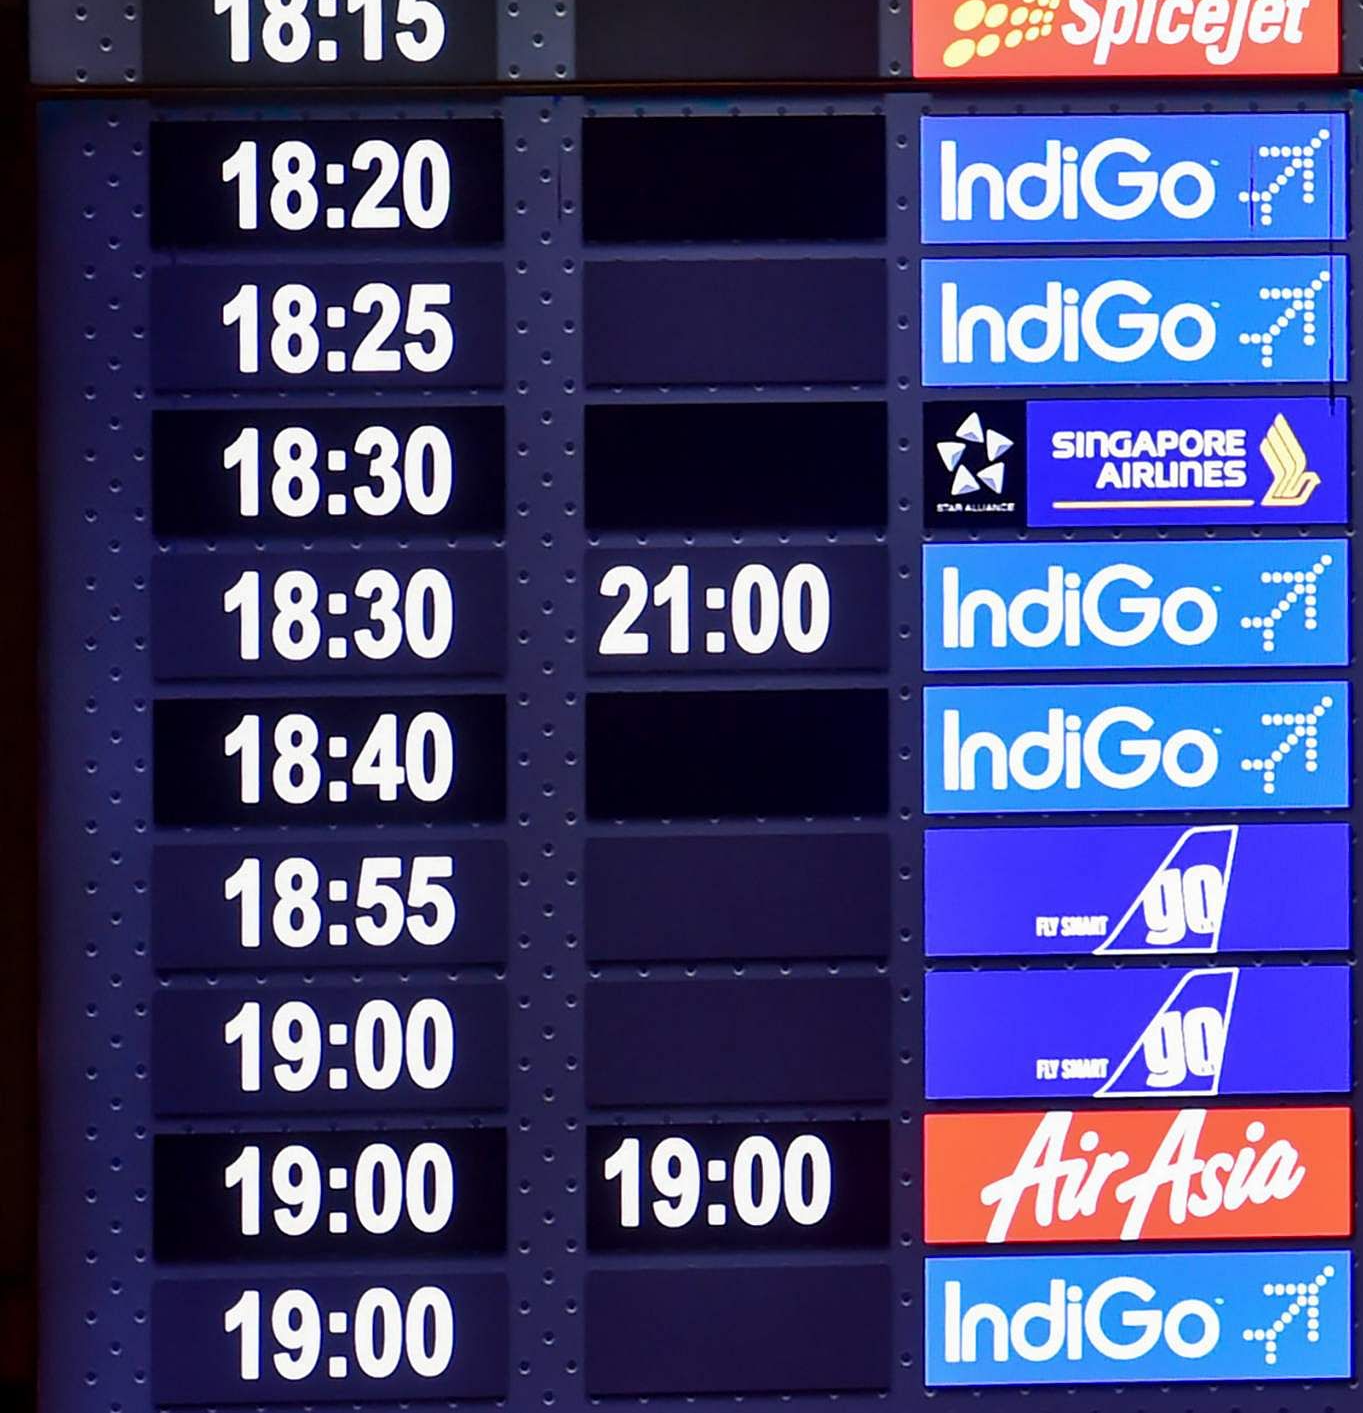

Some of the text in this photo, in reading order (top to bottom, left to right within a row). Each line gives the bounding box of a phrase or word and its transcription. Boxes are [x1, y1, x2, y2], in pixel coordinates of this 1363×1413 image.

[222, 139, 451, 231] 18:20
[940, 137, 1216, 221] IndiGo
[222, 282, 454, 374] 18:25
[941, 279, 1217, 364] IndiGo
[223, 425, 452, 518] 18:30
[1051, 429, 1247, 459] SINGAPORE
[1095, 459, 1247, 489] AIRLINES
[936, 502, 1015, 513] STAR ALLIANCE
[224, 568, 453, 661] 18:30
[598, 563, 830, 655] 21:00
[942, 563, 1218, 649] IndiGo
[224, 711, 454, 804] 18:40
[943, 706, 1219, 791] IndiGo
[224, 856, 456, 948] 18:55
[1035, 915, 1109, 937] FLY SMART
[225, 998, 454, 1092] 19:00
[1036, 1058, 1109, 1080] FLY SMART
[225, 1142, 454, 1236] 19:00
[604, 1134, 832, 1228] 19:00
[224, 1286, 454, 1380] 19:00
[944, 1276, 1221, 1363] IndiGo
